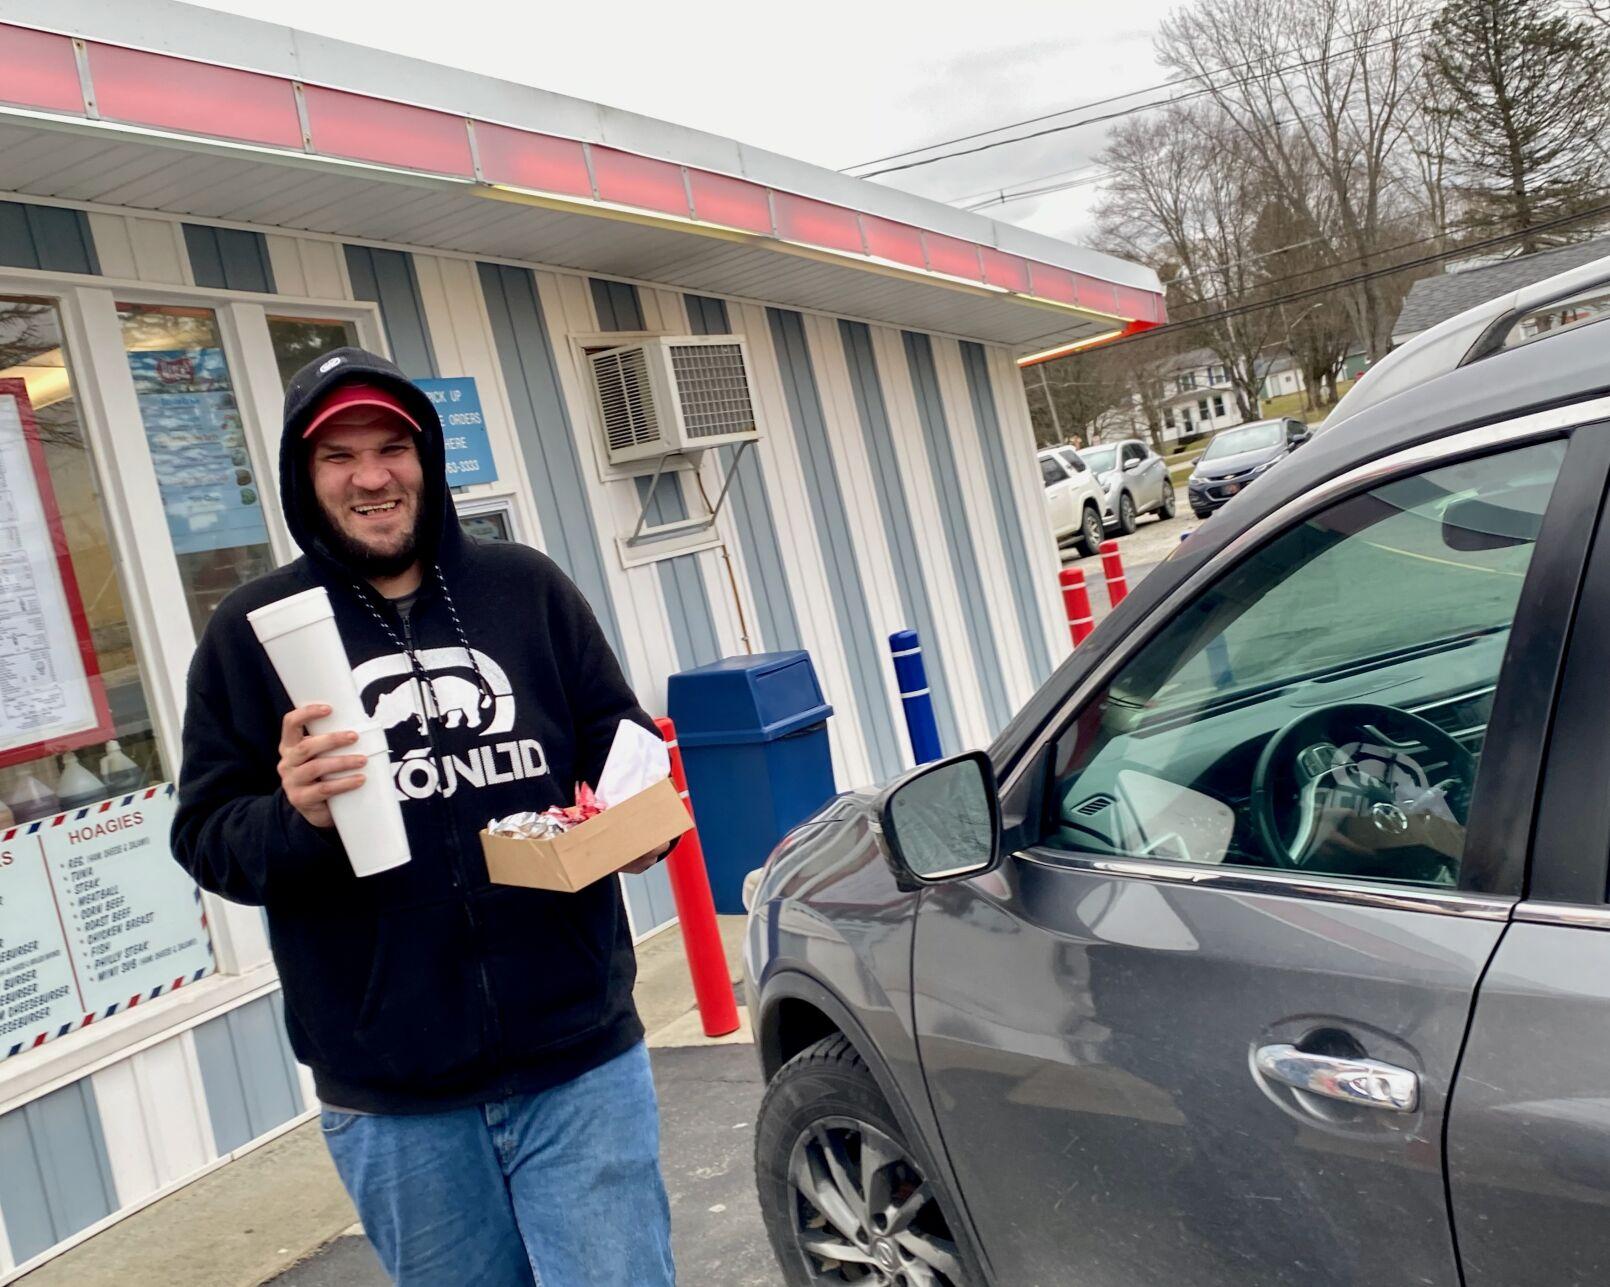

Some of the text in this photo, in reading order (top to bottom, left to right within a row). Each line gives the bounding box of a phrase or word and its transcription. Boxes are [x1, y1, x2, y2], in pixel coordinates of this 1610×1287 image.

[449, 389, 462, 402] UP
[448, 412, 482, 426] ORDERS
[444, 436, 468, 450] HERE
[68, 811, 144, 845] HOAGIES
[74, 877, 101, 895] STEAK
[78, 884, 119, 906] MEATBALL
[105, 896, 125, 911] BEEF
[85, 906, 131, 931] ROAST BEEF
[87, 911, 155, 945] CHICKEN BREAST
[124, 941, 149, 959] STEAK
[3, 968, 37, 991] BURGER
[8, 984, 70, 1018] CHEESEBURGER
